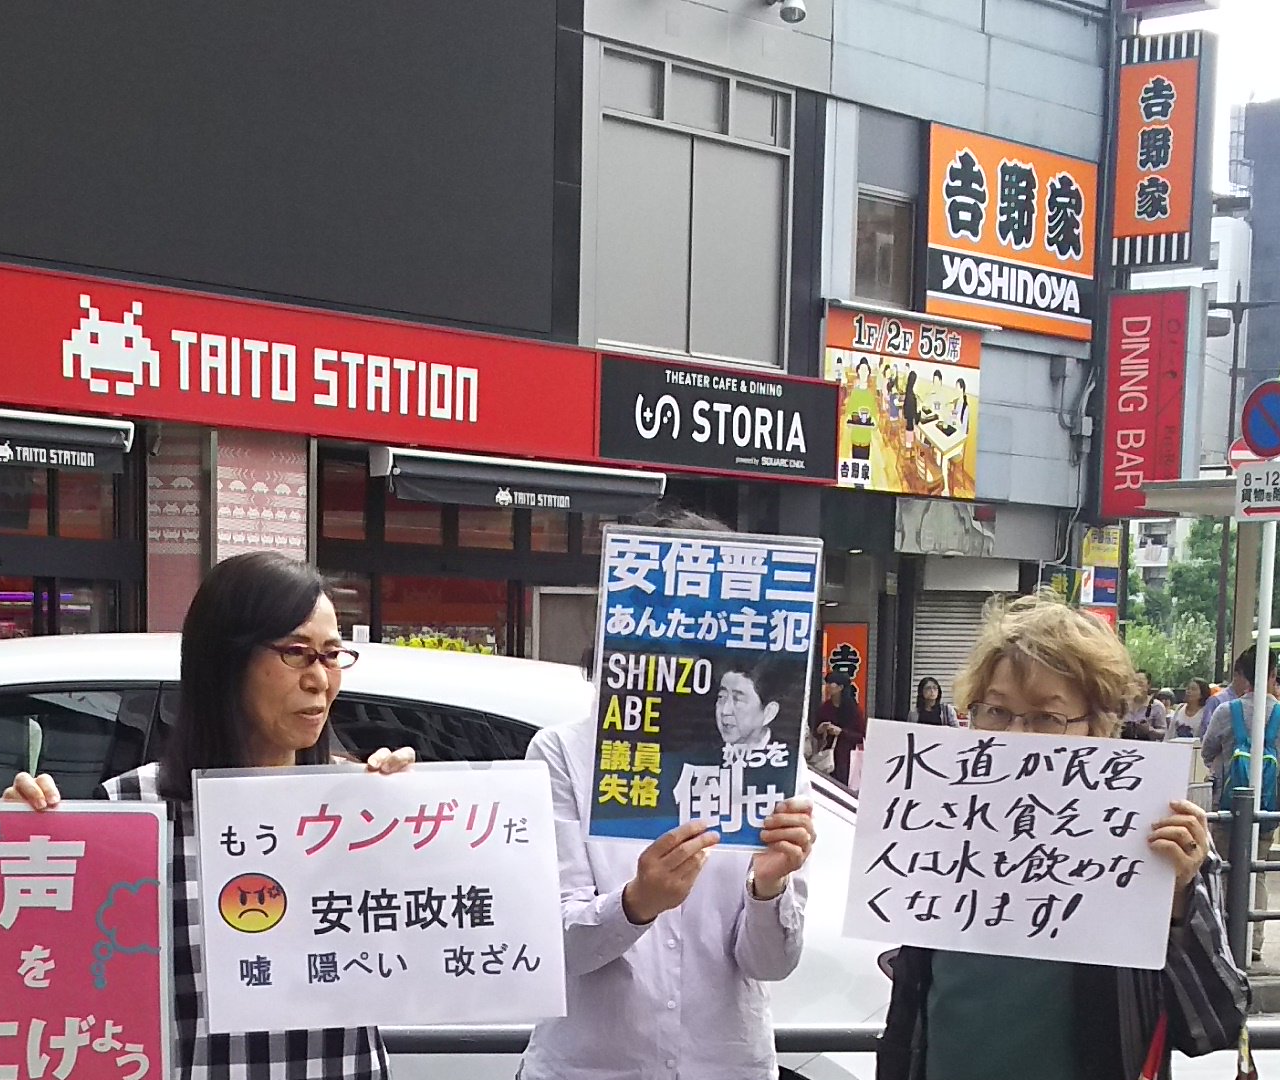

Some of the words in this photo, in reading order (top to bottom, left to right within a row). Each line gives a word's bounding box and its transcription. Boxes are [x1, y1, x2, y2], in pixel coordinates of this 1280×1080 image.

[1134, 75, 1177, 222] 吉野家
[942, 146, 1084, 261] 吉野家
[942, 255, 1081, 314] YOSHINOYA
[171, 328, 296, 402] TAITO
[312, 348, 478, 423] STATION
[665, 369, 709, 388] THEATER
[713, 376, 737, 392] CAFE
[740, 379, 747, 392] &
[750, 381, 782, 397] DINING
[1118, 316, 1151, 413] DINING
[692, 400, 807, 454] STORIA
[16, 446, 47, 463] TAITO
[50, 448, 95, 467] STATION
[1114, 429, 1145, 491] BAR
[607, 538, 816, 602] 安倍晋三
[606, 605, 811, 652] あんたが主犯
[606, 653, 713, 696] SHINZO
[602, 694, 662, 734] ABE
[599, 740, 662, 774] 議員
[885, 732, 1145, 791] 水道が民営
[598, 773, 661, 808] 失格
[673, 763, 784, 833] 倒せ
[865, 839, 1144, 889] 人は水も飲めな
[311, 884, 495, 935] 安倍政権
[867, 886, 1084, 940] くなります!
[18, 944, 56, 988] を
[239, 955, 273, 987] 嘘
[307, 951, 408, 984] 隠ぺい
[443, 943, 541, 978] 改ざん
